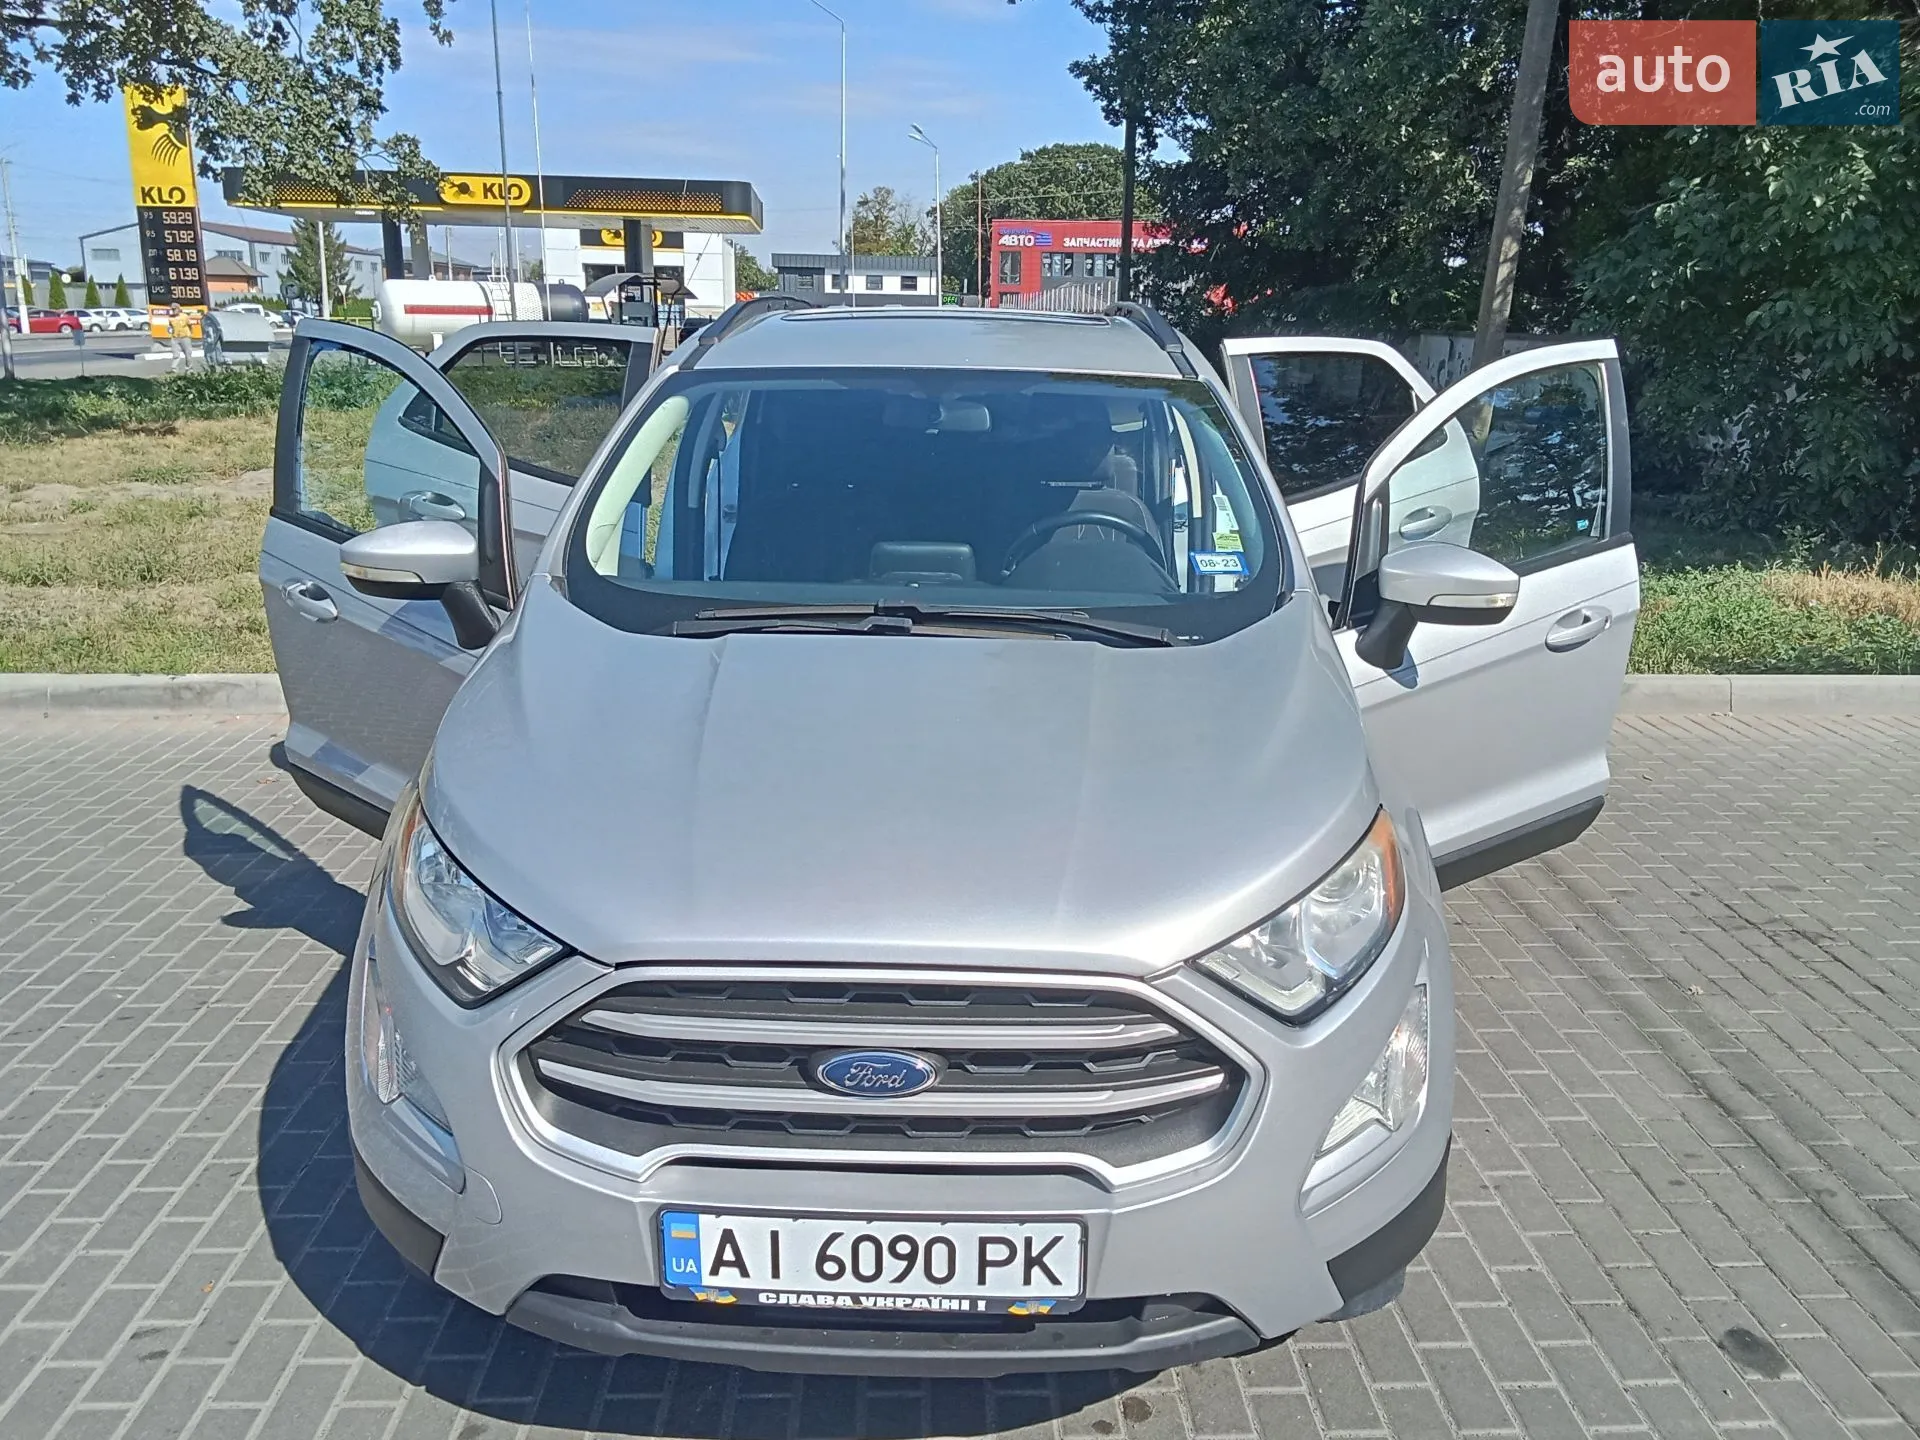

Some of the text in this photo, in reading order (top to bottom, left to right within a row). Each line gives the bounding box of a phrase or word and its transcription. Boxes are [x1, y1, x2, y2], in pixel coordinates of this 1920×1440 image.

[141, 186, 186, 205] KLO
[483, 182, 523, 201] KLO
[998, 234, 1035, 247] АВТО
[1063, 237, 1122, 248] ЗАПЧАСТИН
[843, 1061, 906, 1090] Ford
[671, 1256, 699, 1275] UA
[708, 1227, 1065, 1287] AI 6090 PK
[757, 1291, 855, 1306] СЛАВА
